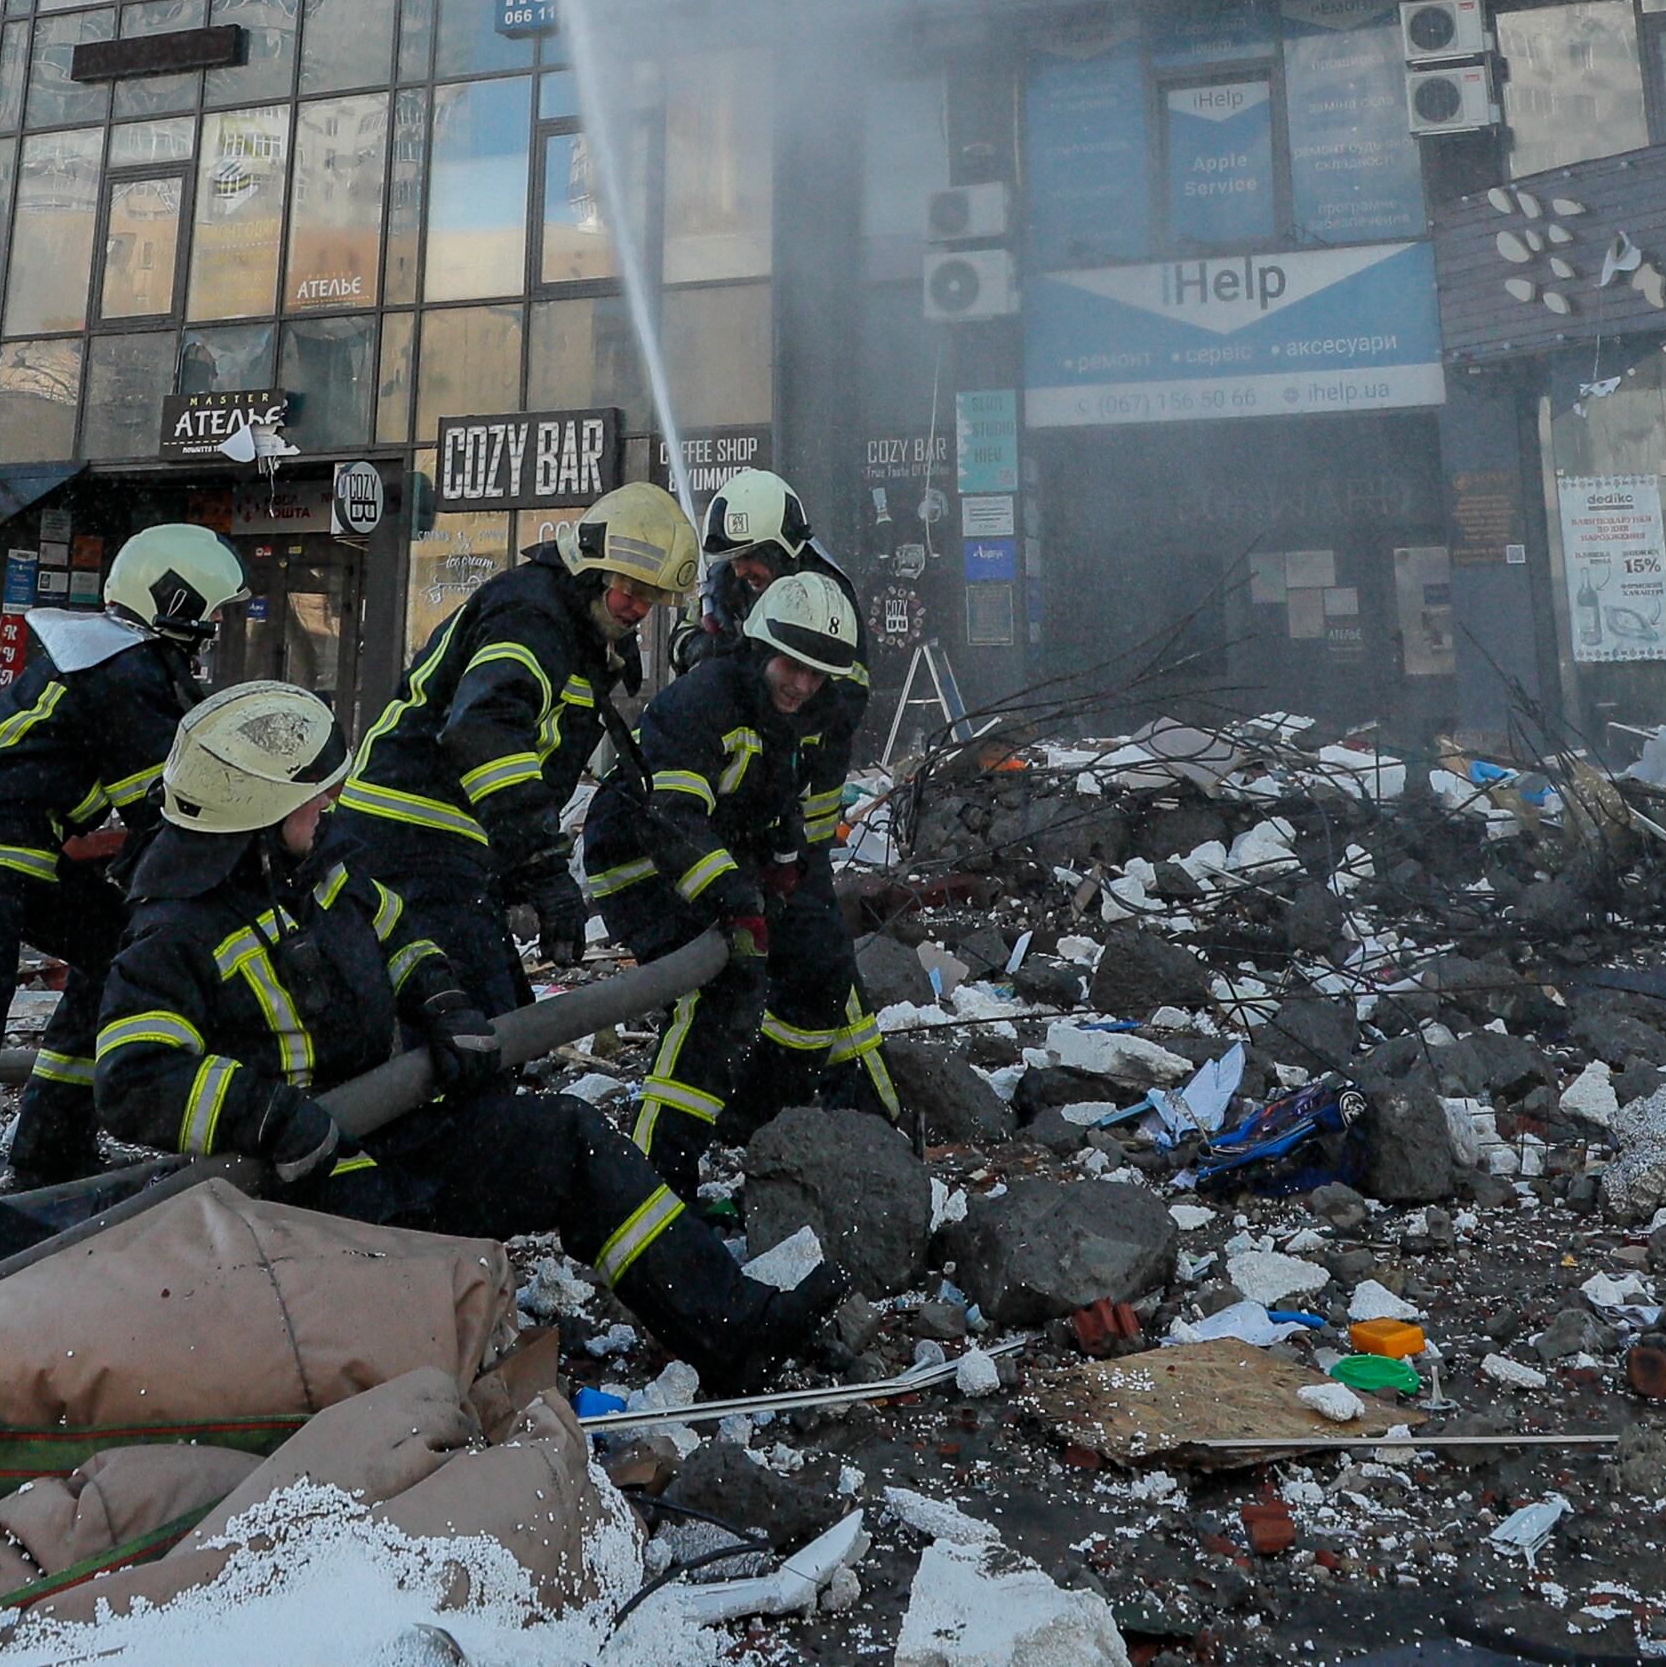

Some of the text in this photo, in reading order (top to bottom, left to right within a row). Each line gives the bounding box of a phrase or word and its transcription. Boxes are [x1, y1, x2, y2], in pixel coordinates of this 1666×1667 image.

[504, 5, 555, 25] 066 11
[1193, 91, 1244, 110] iHelp
[1294, 143, 1348, 160] ремонт
[1193, 154, 1247, 174] Apple
[1185, 177, 1258, 197] Service
[297, 277, 362, 299] АТЕЛЬЄ
[1161, 257, 1287, 310] iHelp
[1078, 334, 1398, 372] ремонт сервіс аксесуари
[189, 393, 269, 406] MASTER
[1098, 381, 1391, 417] (067) 156 50 66 ihelp.ua
[443, 418, 604, 500] COZY BAR
[660, 437, 758, 465] CFFEE SHOP
[868, 437, 947, 464] COZY BAR
[867, 465, 884, 479] True
[887, 464, 910, 478] Taste
[350, 474, 377, 500] COZY
[1587, 493, 1633, 504] dediko
[263, 508, 311, 519] ПОШТА
[1624, 558, 1661, 574] 15%
[885, 600, 908, 617] COZY
[829, 616, 839, 635] 8
